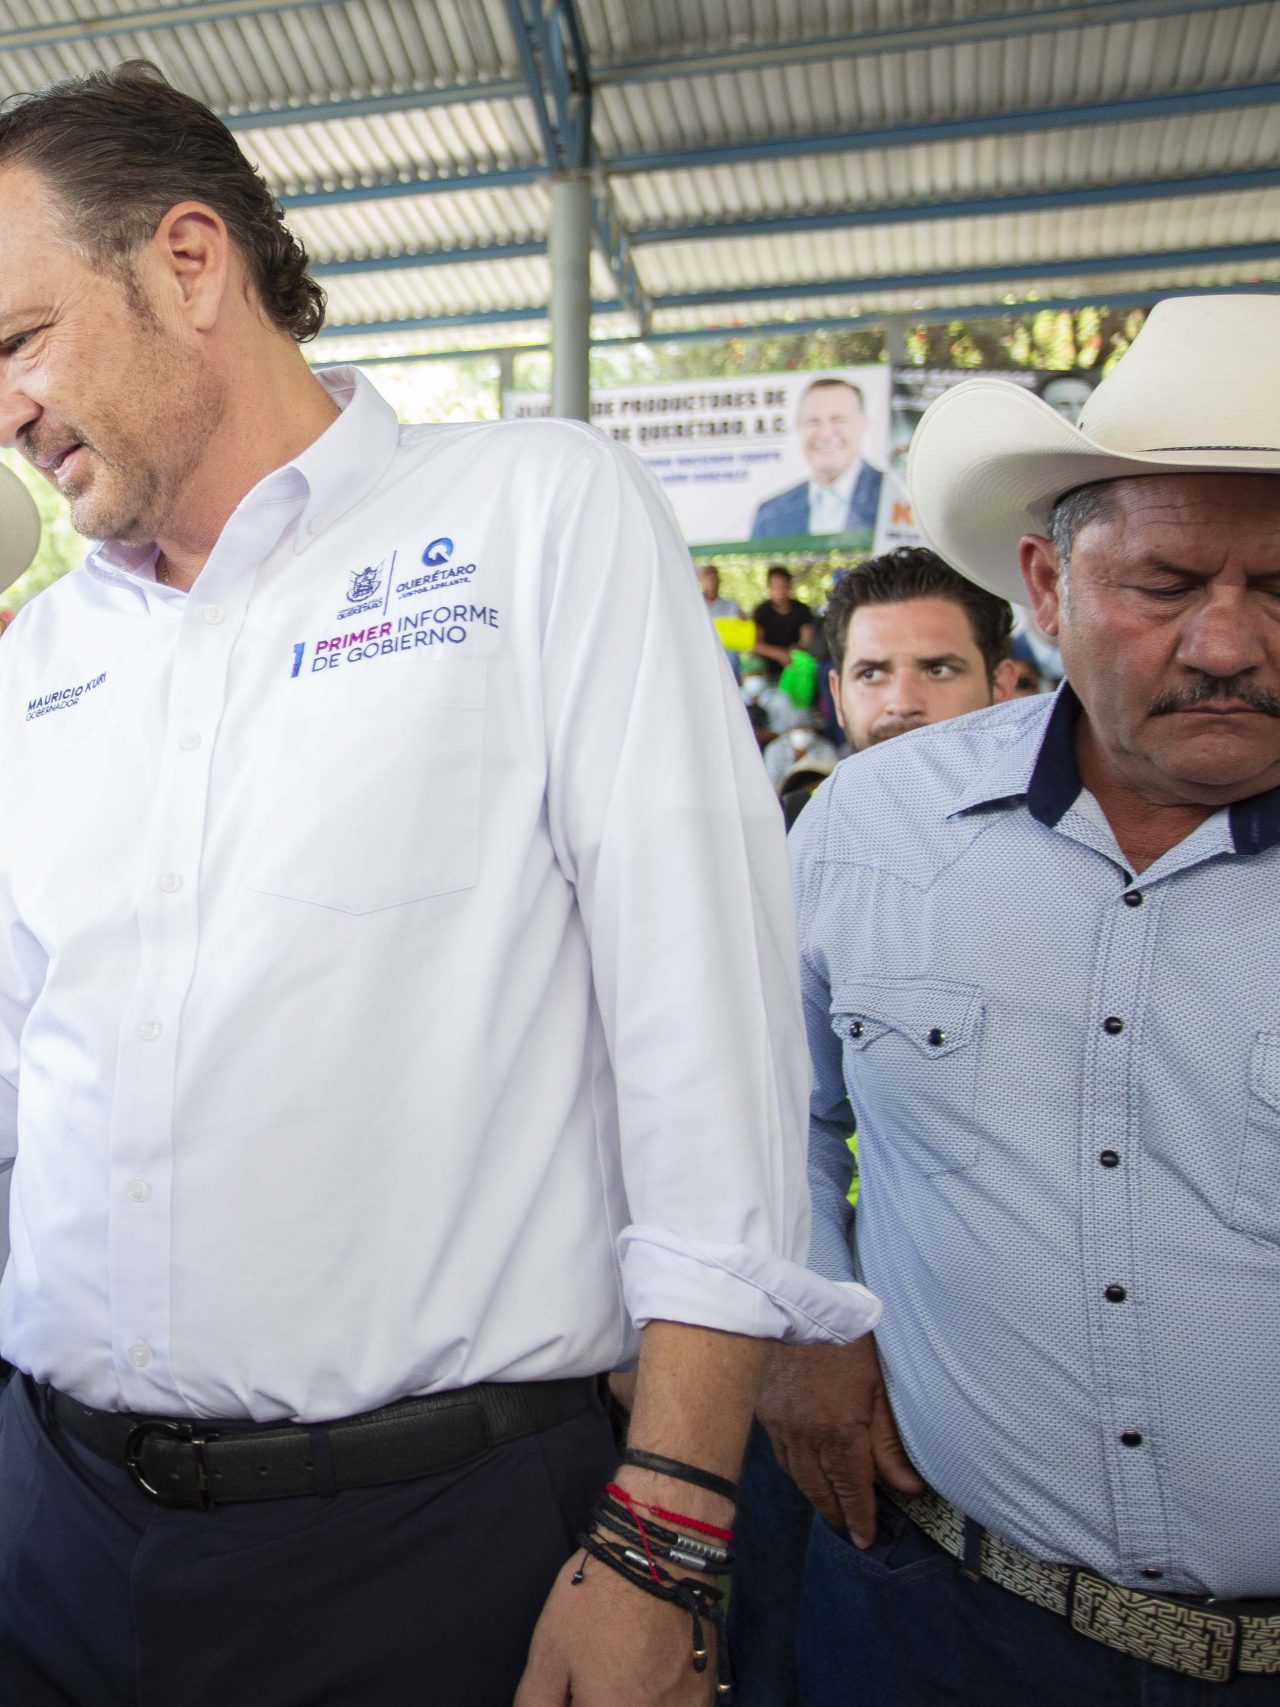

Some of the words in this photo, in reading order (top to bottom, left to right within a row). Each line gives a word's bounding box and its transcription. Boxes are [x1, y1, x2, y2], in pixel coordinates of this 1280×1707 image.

[621, 391, 757, 415] PRODUCTORES
[764, 389, 787, 407] DE
[396, 564, 477, 592] QUERÉTARO
[315, 621, 393, 655] PRIMER
[397, 604, 500, 633] INFORME
[311, 653, 342, 672] DE
[346, 625, 467, 663] GOBIERNO
[25, 698, 80, 721] GOBERNADOR
[27, 685, 84, 712] MAURICIO
